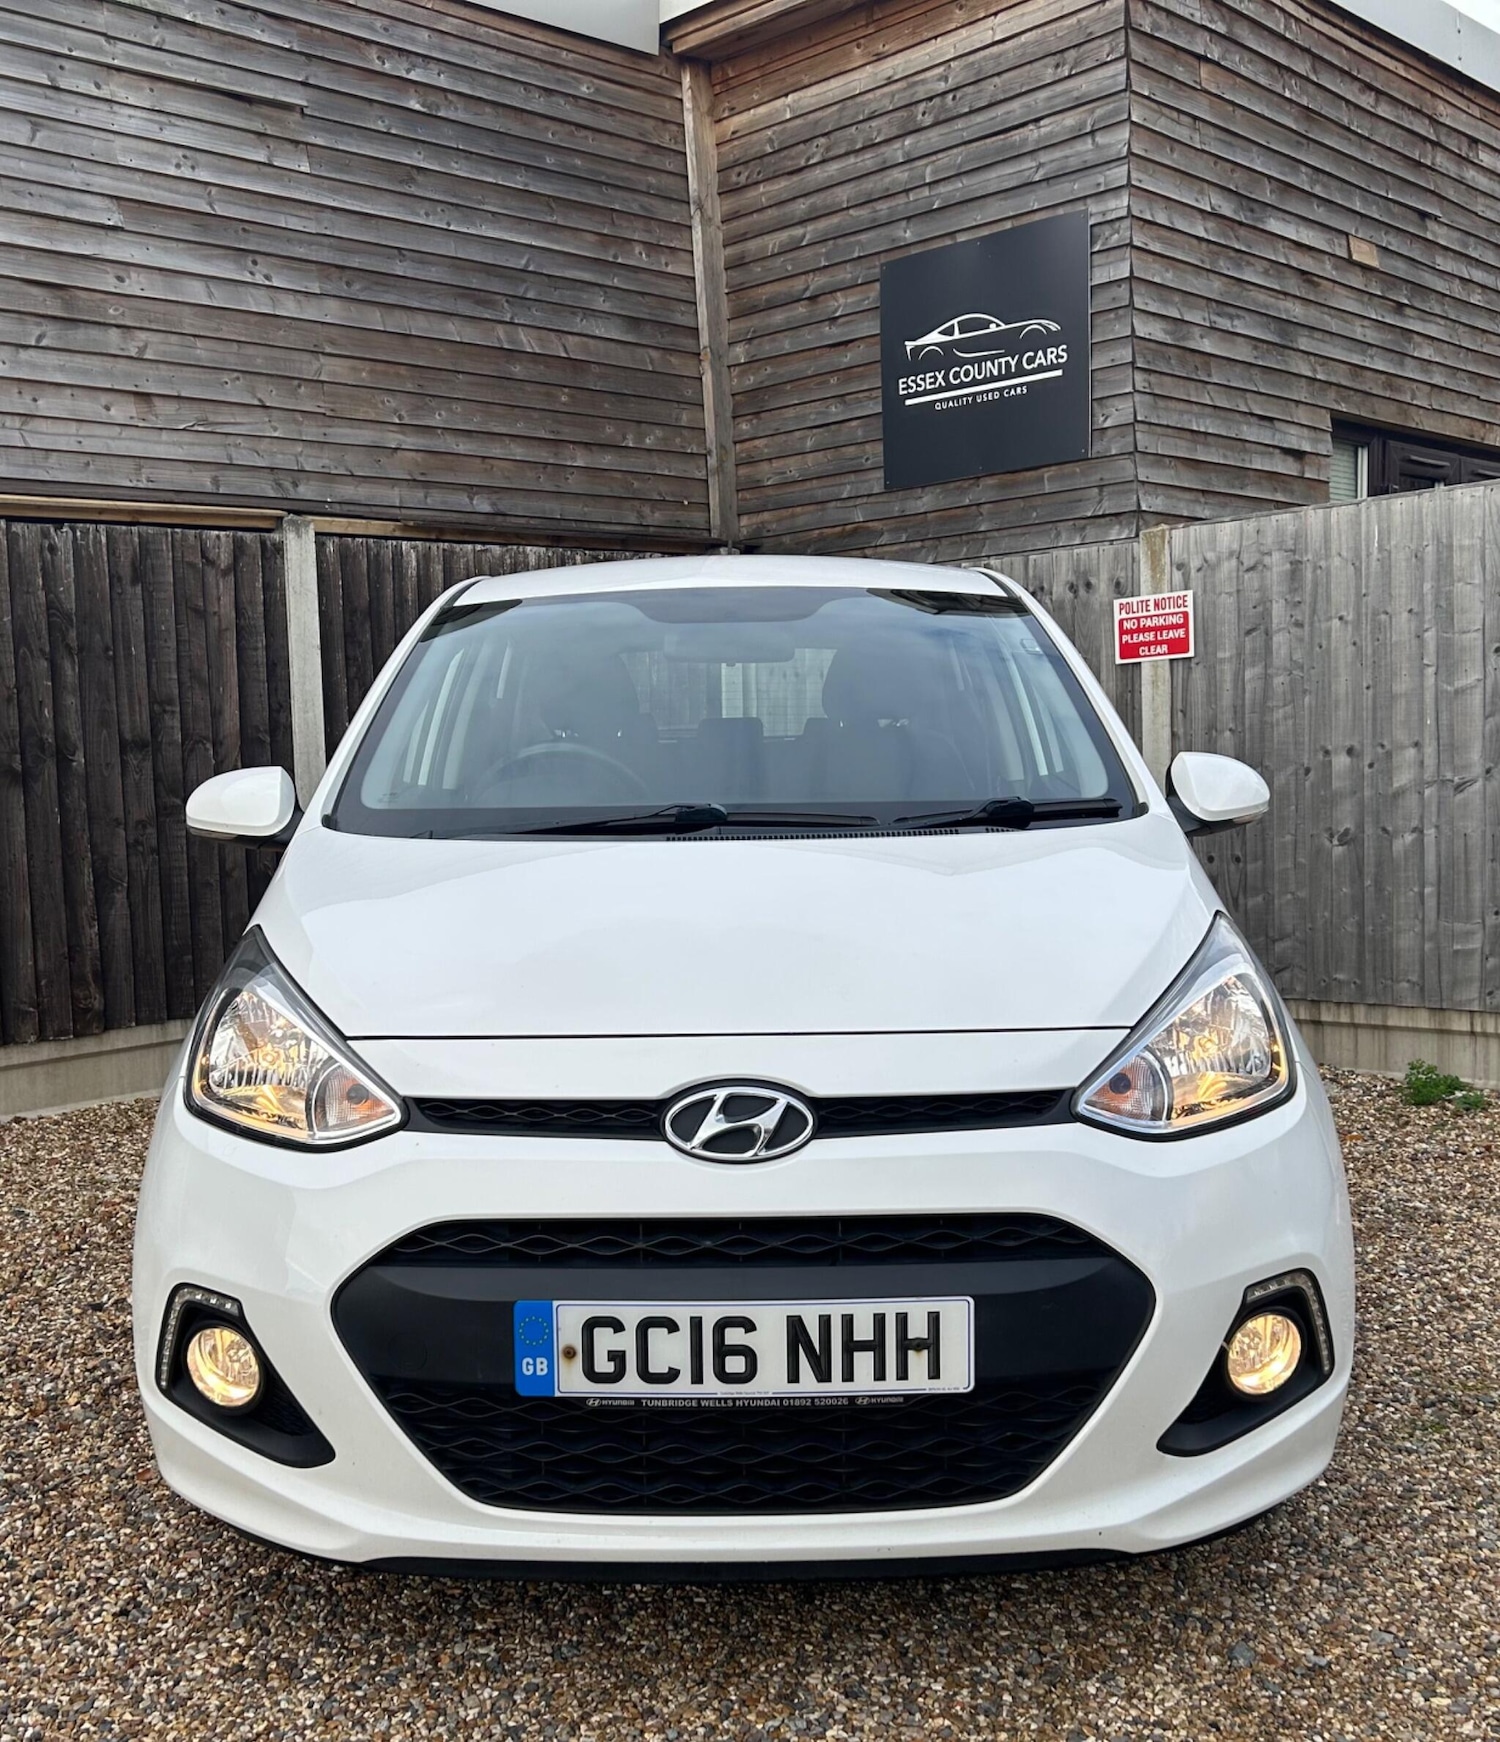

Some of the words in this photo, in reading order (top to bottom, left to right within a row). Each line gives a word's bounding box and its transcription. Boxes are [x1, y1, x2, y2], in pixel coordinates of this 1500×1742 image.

[898, 369, 946, 395] ESSEX
[949, 354, 1019, 385] COUNTY
[1022, 344, 1068, 370] CARS
[934, 396, 973, 411] QUALITY
[976, 391, 1000, 403] USED
[1003, 386, 1028, 398] CARS
[1119, 599, 1150, 616] POLITE
[1153, 594, 1188, 612] NOTICE
[1123, 619, 1138, 630] NO
[1140, 613, 1184, 628] PARKING
[1122, 631, 1155, 644] PLEASE
[1157, 628, 1186, 640] LEAVE
[1139, 644, 1168, 656] CLEAR
[581, 1316, 758, 1385] GC16
[786, 1311, 941, 1384] NHH
[521, 1357, 549, 1376] GB
[641, 1399, 698, 1407] TUNBRIDGE
[700, 1399, 734, 1408] WELLS
[735, 1399, 780, 1407] HYUNDAI
[782, 1398, 811, 1407] 01892
